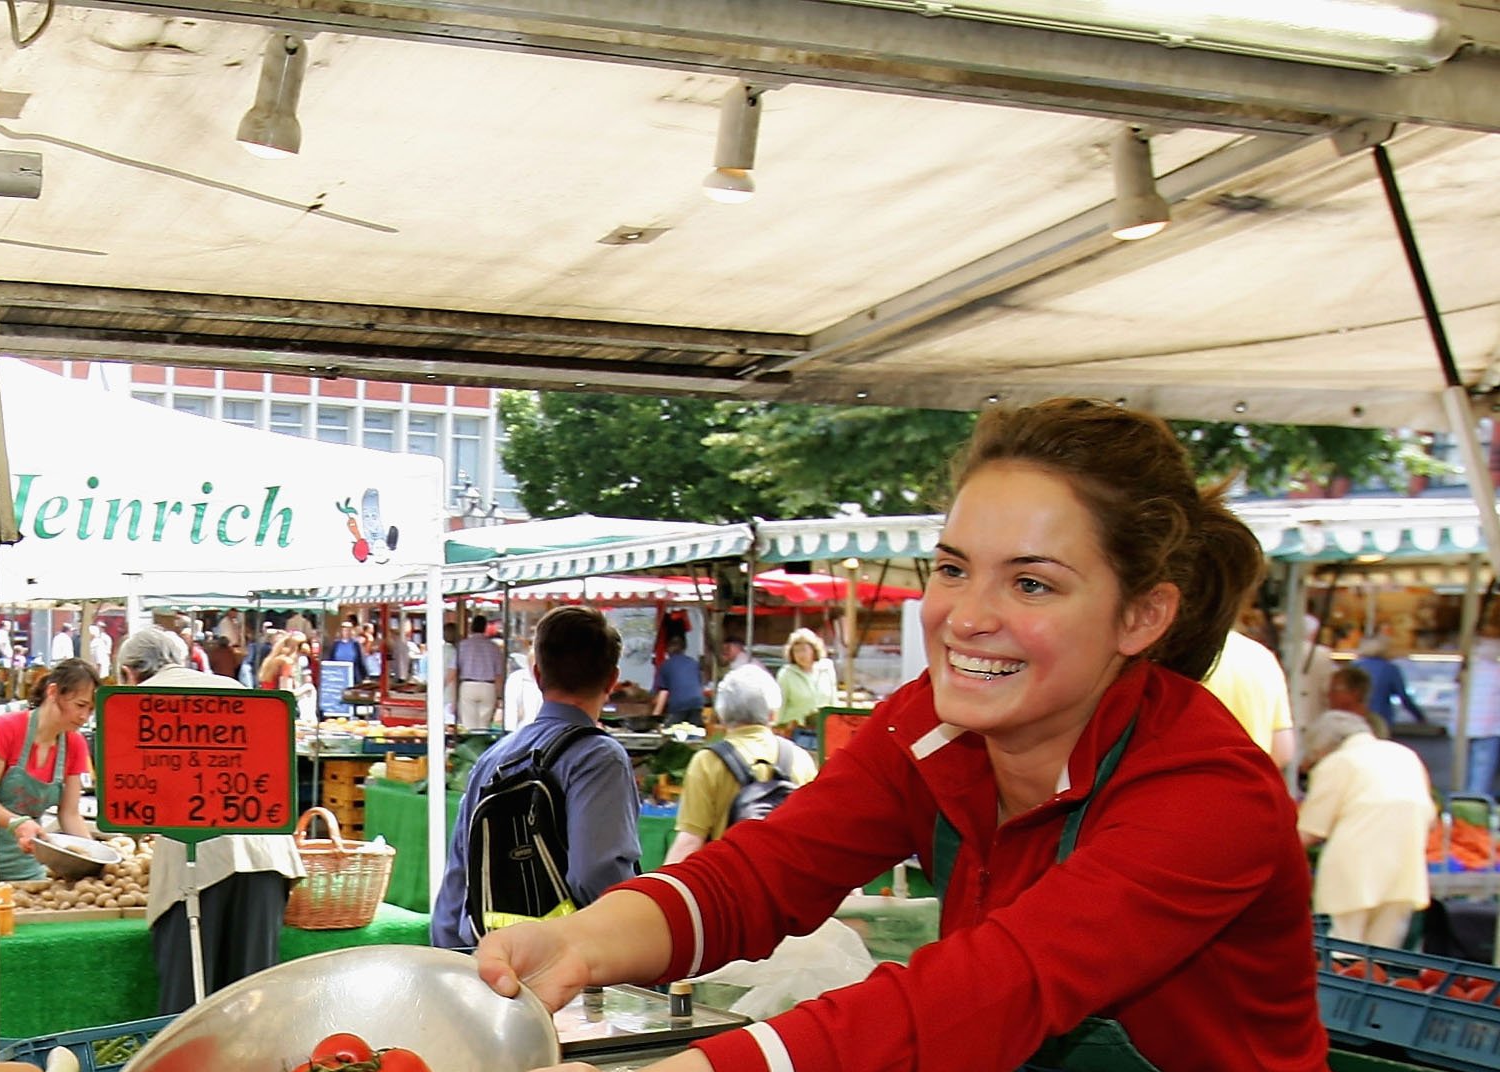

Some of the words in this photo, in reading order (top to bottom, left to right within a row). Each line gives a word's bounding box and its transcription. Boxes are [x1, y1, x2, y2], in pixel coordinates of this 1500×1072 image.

[139, 697, 245, 714] deutsche
[138, 715, 247, 743] Bohnen
[142, 754, 181, 771] jung
[188, 752, 200, 767] &
[208, 753, 242, 768] zart
[114, 774, 157, 795] 500g
[110, 801, 156, 825] 1Kg
